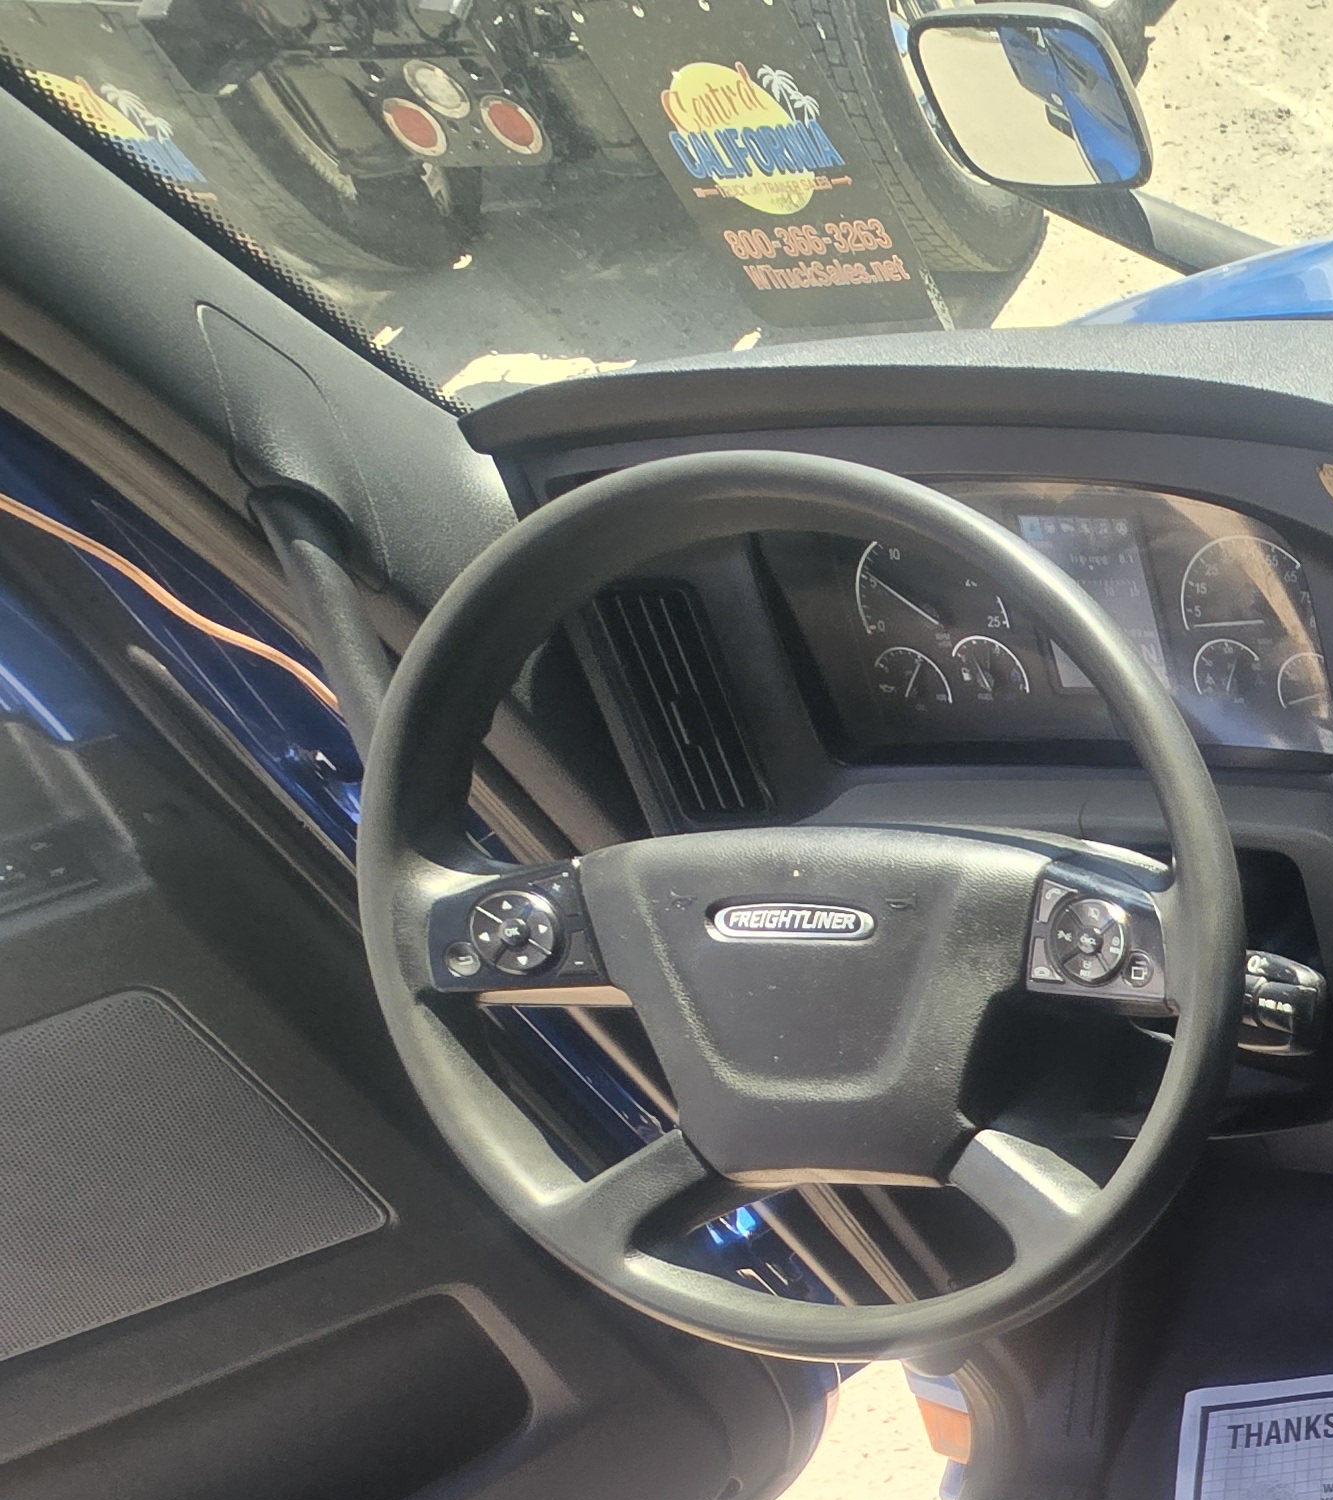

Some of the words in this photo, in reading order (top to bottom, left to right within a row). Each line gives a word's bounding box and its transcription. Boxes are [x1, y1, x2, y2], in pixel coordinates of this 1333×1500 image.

[661, 61, 768, 135] Central
[668, 119, 846, 180] CALIFORNIA
[715, 184, 749, 198] TRUCK
[723, 218, 893, 260] 800-366-3263
[743, 254, 911, 290] WTruckSales.net
[888, 548, 901, 560] 10
[1195, 583, 1207, 595] 15
[1194, 606, 1202, 617] 5
[987, 616, 1001, 628] 25
[729, 909, 857, 930] FREIGHTLINER
[504, 926, 521, 938] OK
